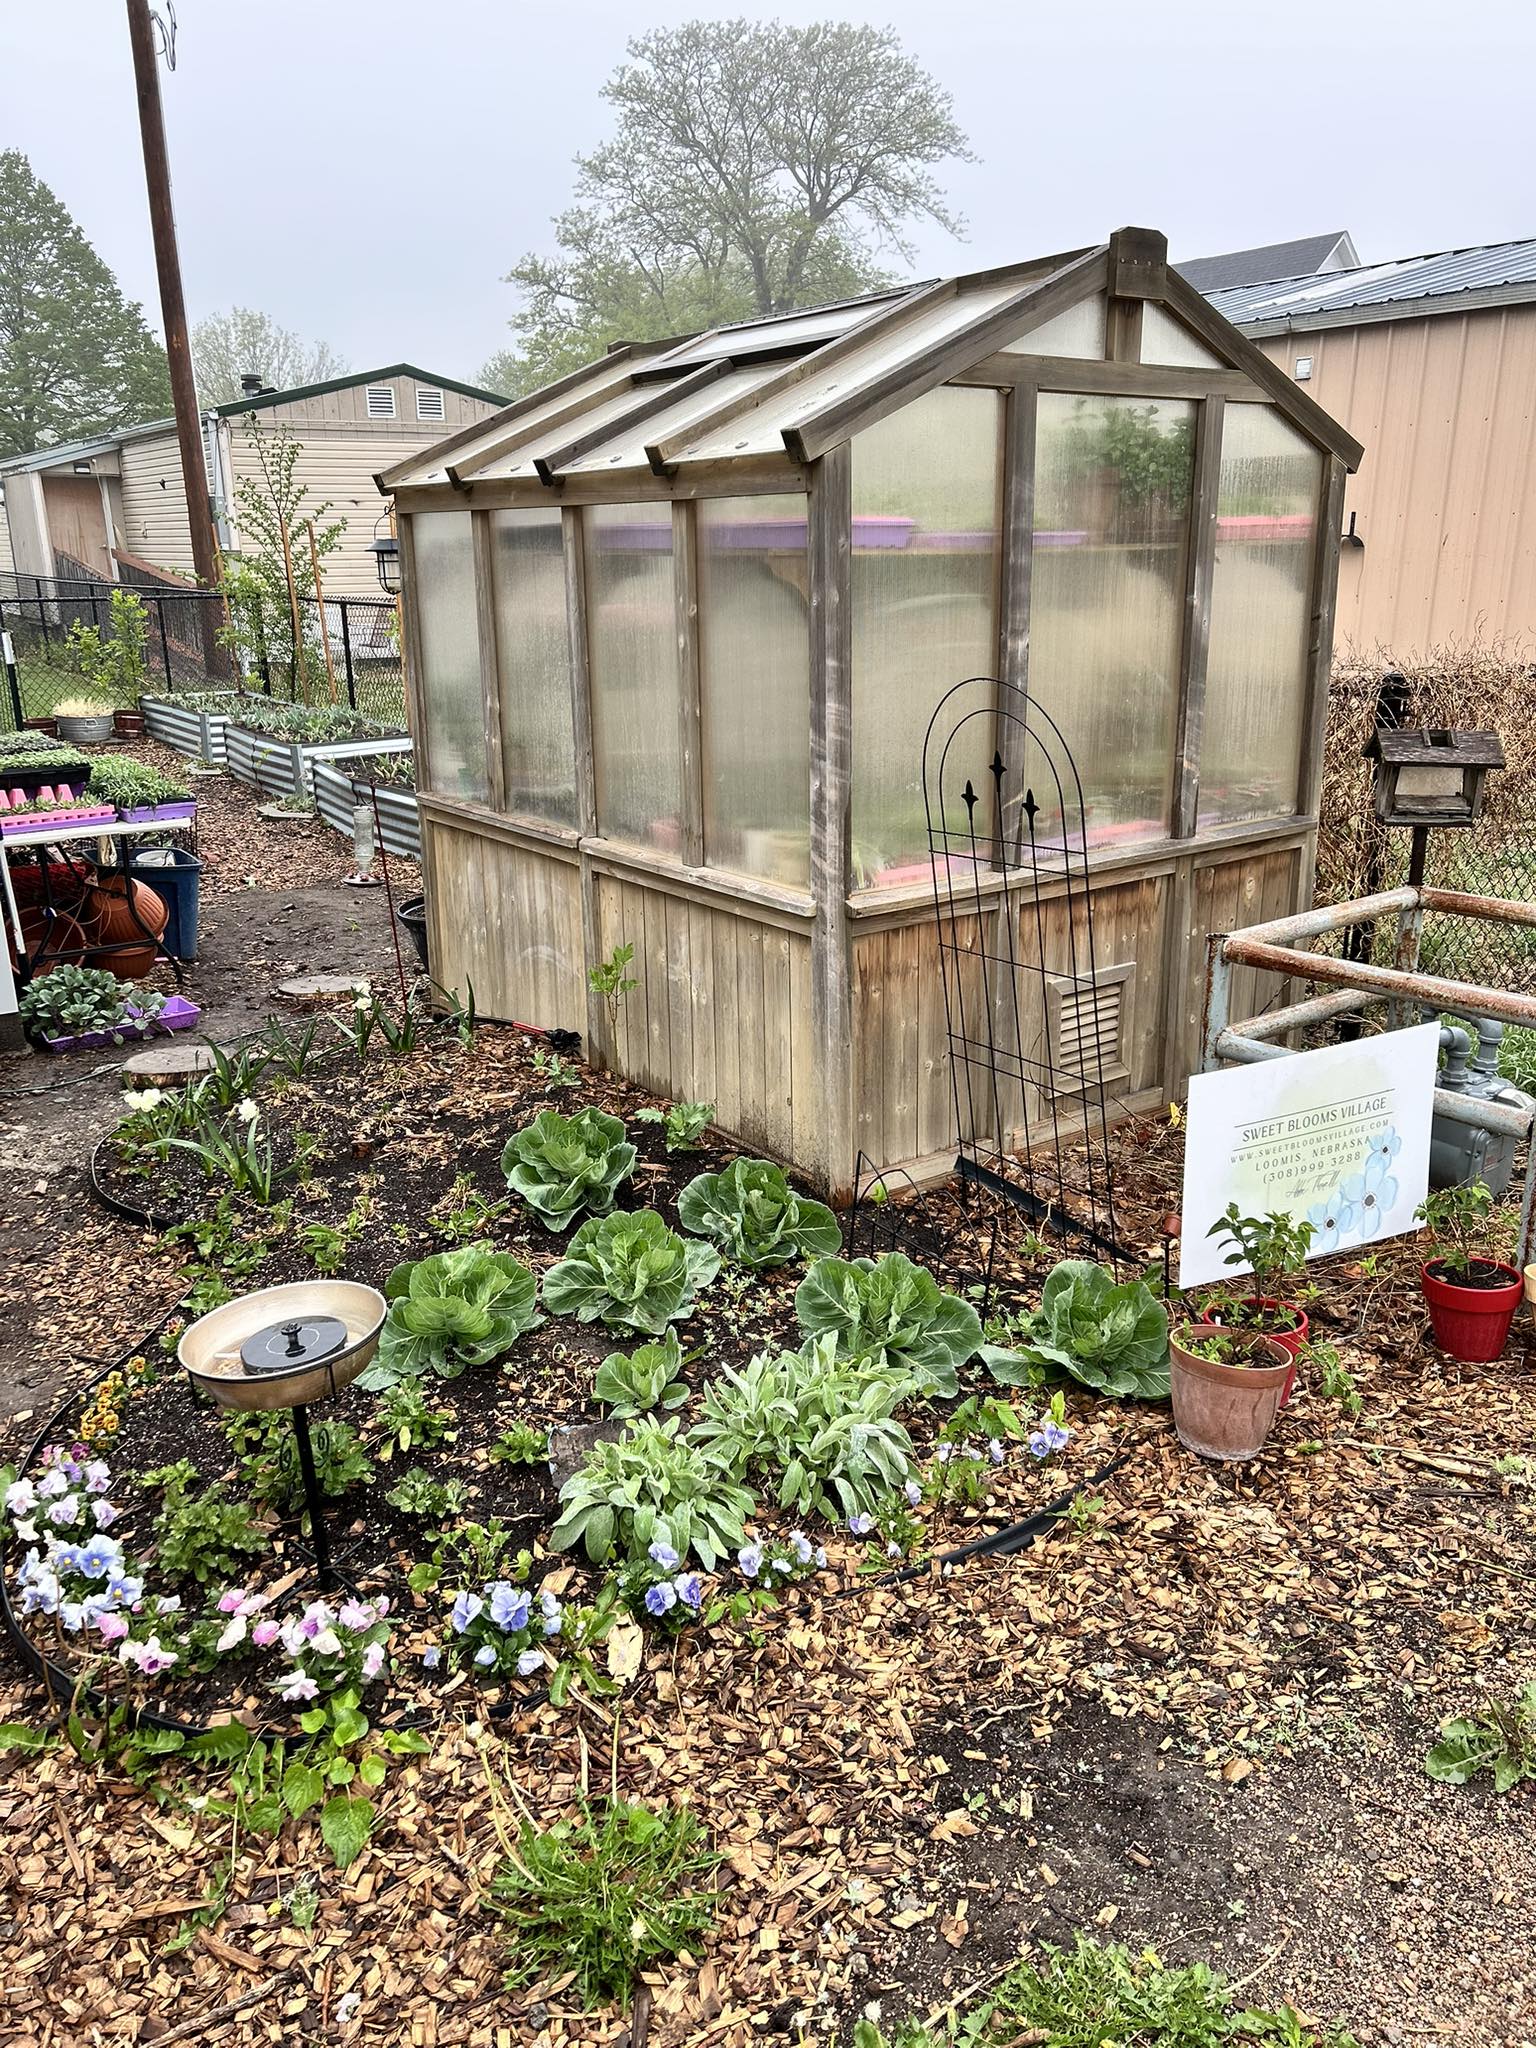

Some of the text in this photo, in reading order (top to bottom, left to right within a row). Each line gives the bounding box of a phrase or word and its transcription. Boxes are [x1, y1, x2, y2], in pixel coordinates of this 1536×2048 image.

[1242, 1097, 1387, 1142] SWEET BLOOMS VILLAGE
[1312, 1135, 1371, 1158] NEBRASKA
